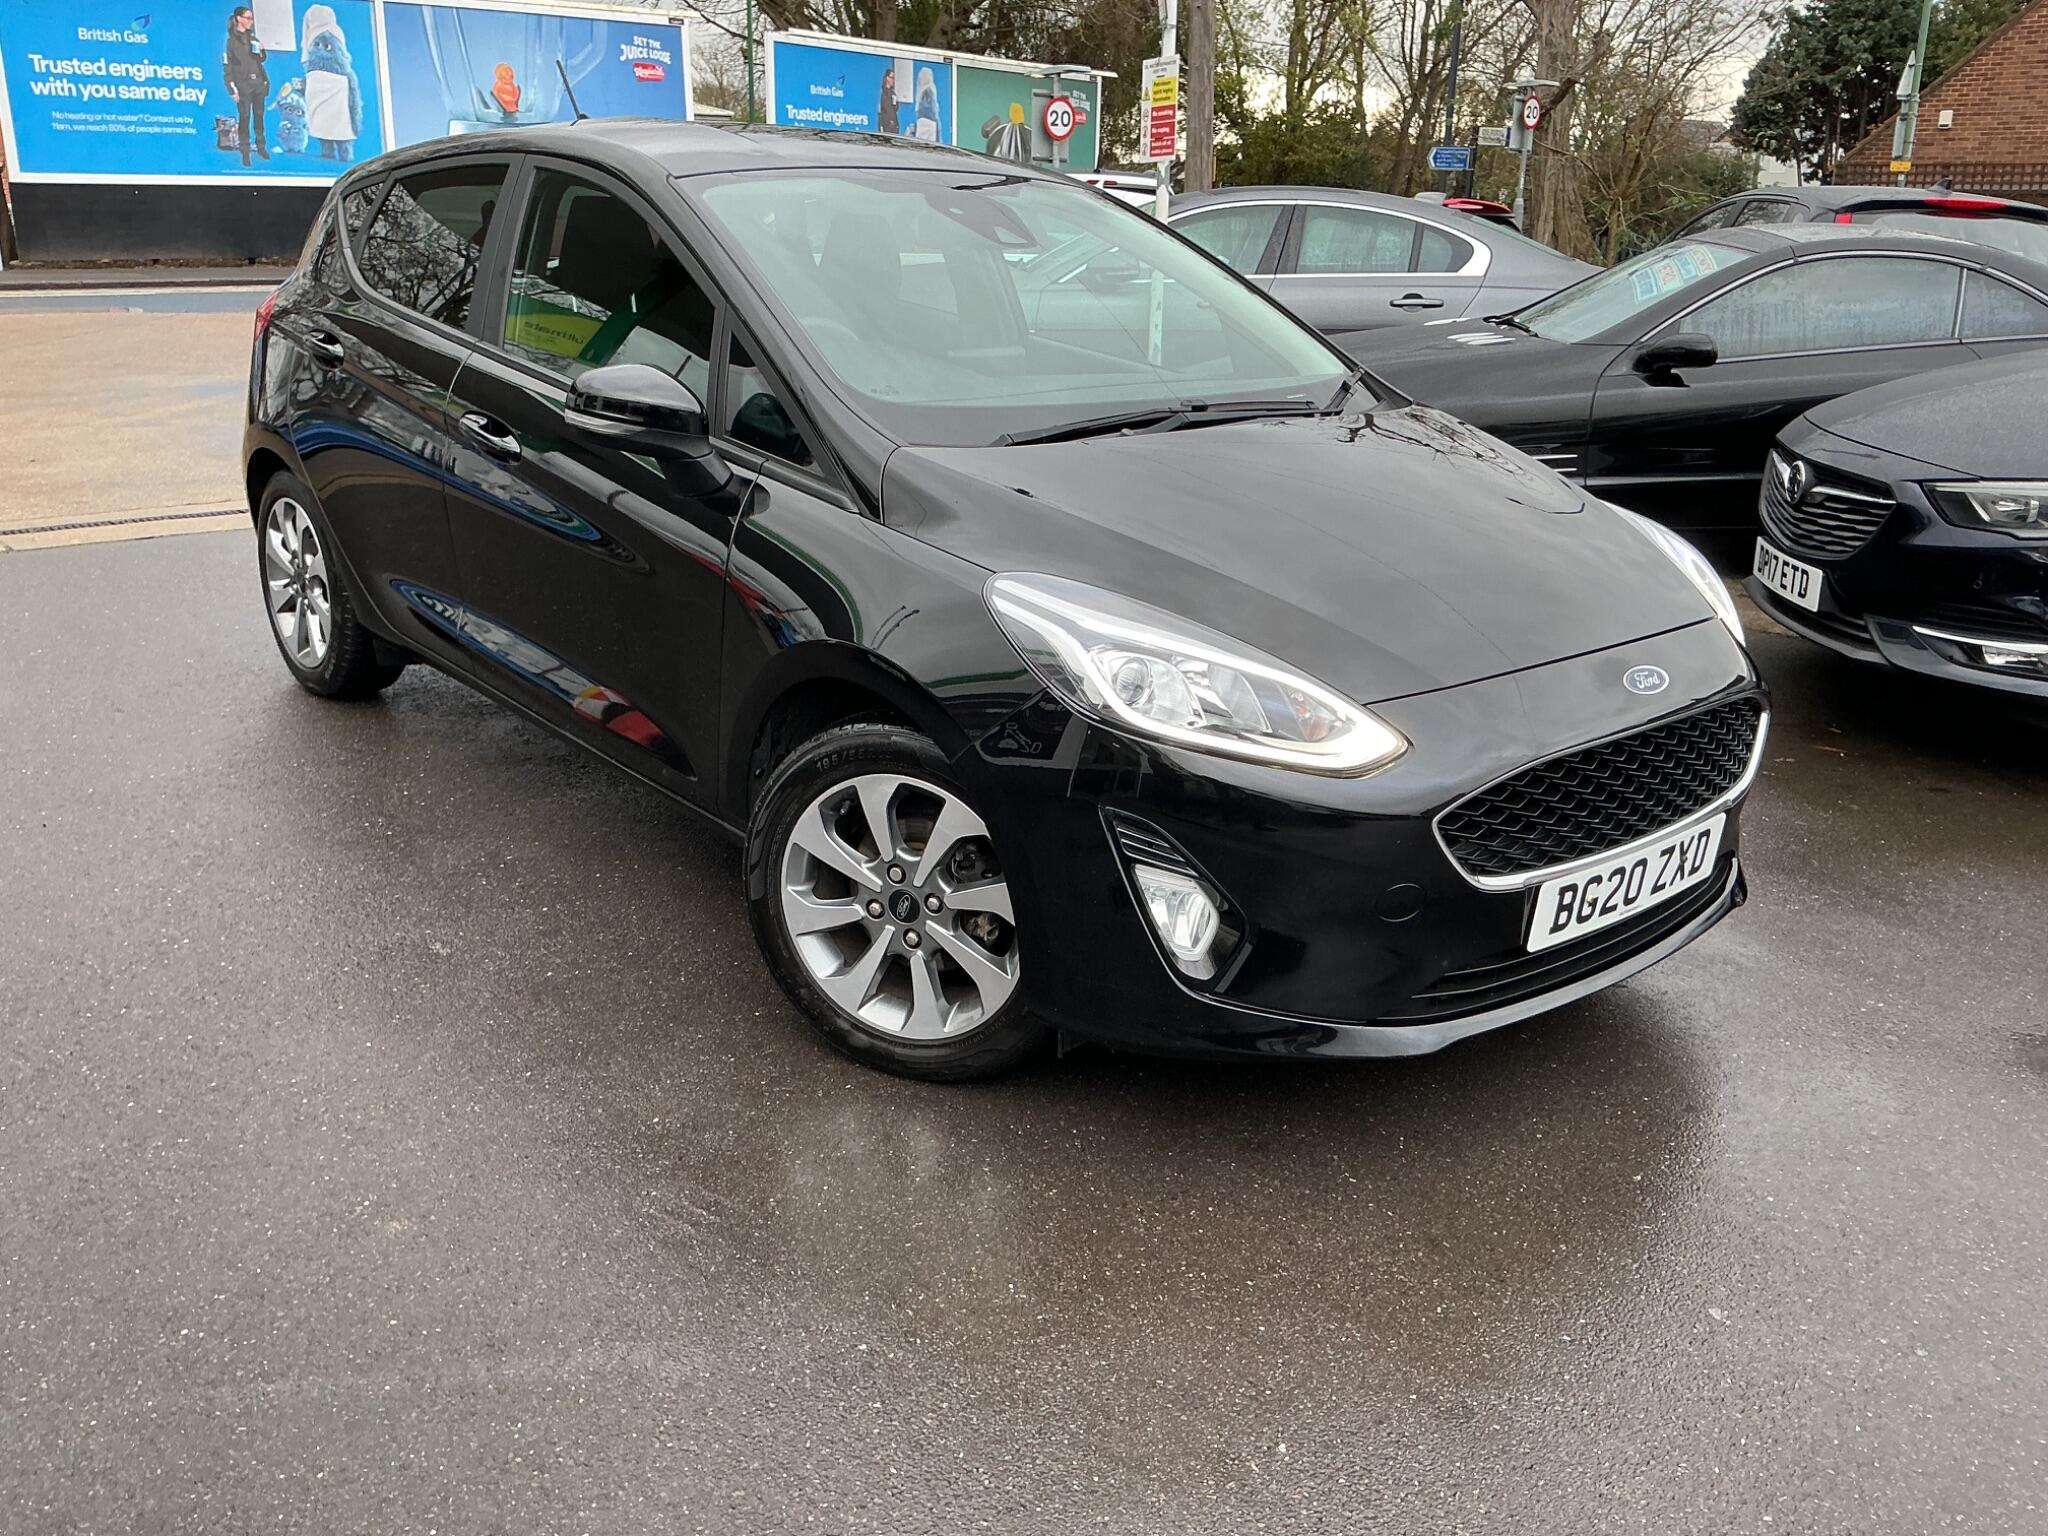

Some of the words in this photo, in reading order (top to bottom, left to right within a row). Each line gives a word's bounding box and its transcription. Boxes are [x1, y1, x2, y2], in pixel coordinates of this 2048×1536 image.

[78, 27, 122, 42] British
[124, 31, 149, 44] Gas
[633, 35, 648, 47] SET
[620, 44, 648, 61] JUICE
[649, 49, 672, 64] LOOSE
[28, 54, 107, 76] Trusted
[109, 59, 203, 82] engineers
[29, 77, 77, 97] with
[79, 83, 116, 101] you
[119, 85, 171, 100] same
[173, 84, 207, 106] day
[809, 84, 831, 96] British
[831, 87, 844, 98] Gas
[785, 104, 822, 122] Trusted
[823, 108, 869, 127] engineers
[1050, 110, 1071, 127] 20
[1526, 105, 1539, 119] 20
[1780, 559, 1810, 599] ETD
[1548, 857, 1649, 935] BG20
[1650, 828, 1712, 897] ZXD
